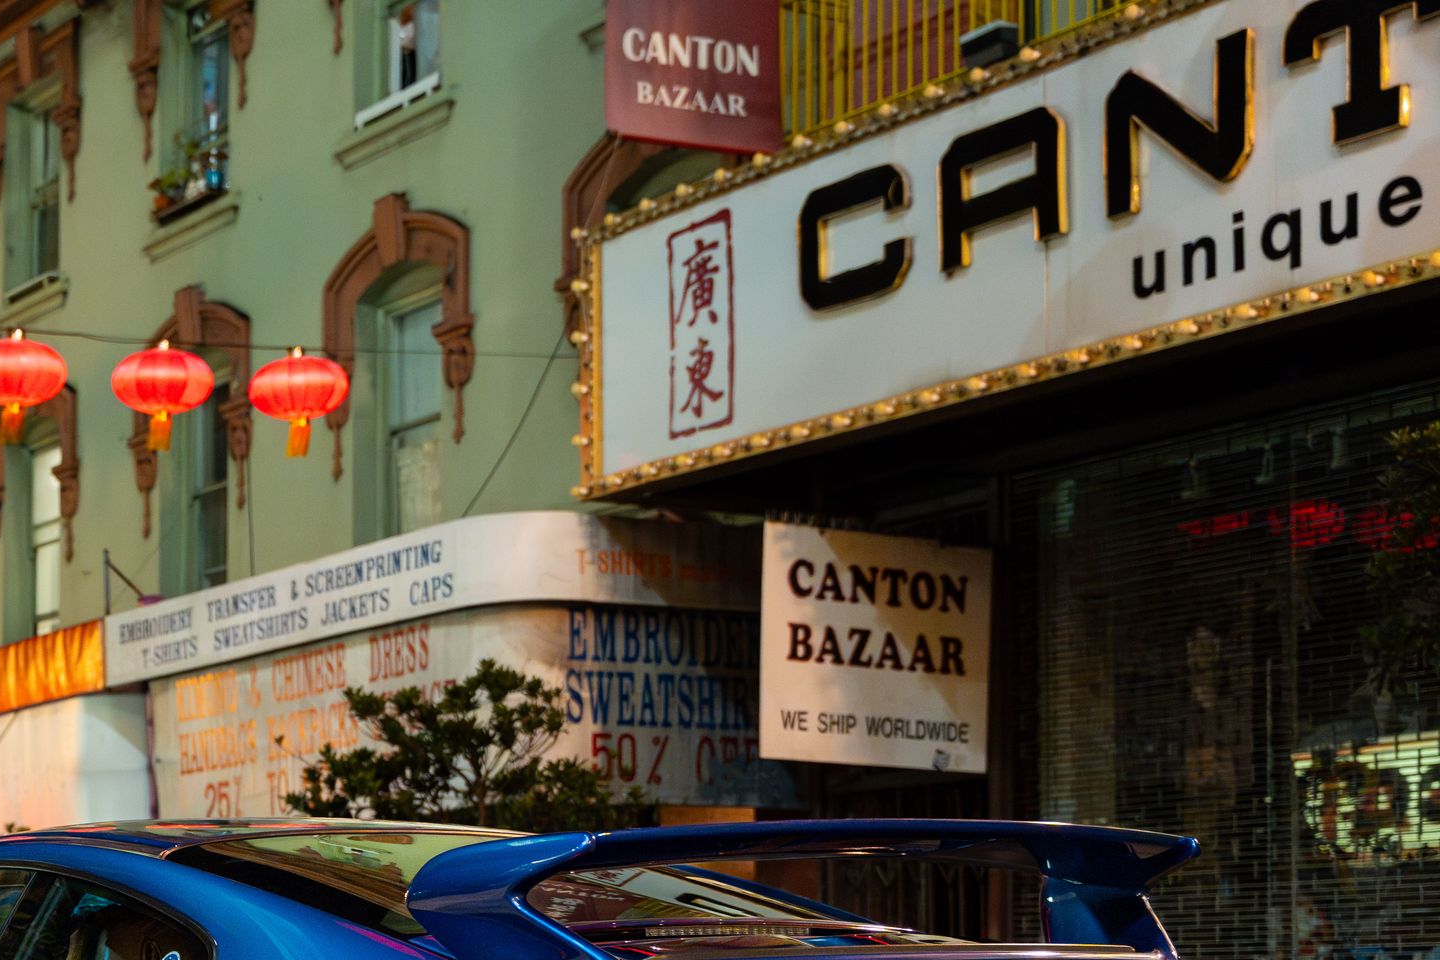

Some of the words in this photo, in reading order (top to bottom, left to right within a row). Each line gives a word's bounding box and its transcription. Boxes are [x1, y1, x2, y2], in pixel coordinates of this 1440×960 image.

[622, 27, 759, 77] CANTON
[637, 81, 748, 117] BAZAAR
[798, 0, 1440, 312] CANT
[1132, 175, 1423, 298] unique
[674, 238, 725, 418] 廣東
[576, 547, 672, 577] T-SHIRTS
[788, 559, 968, 614] CANTON
[119, 606, 195, 645] EMBROIDERY
[206, 584, 277, 622] TRANSFER
[213, 607, 308, 651] SWEATSHIRTS
[320, 588, 390, 626] JACKETS
[409, 572, 454, 607] CAPS
[271, 642, 346, 704] CHINESE
[368, 623, 430, 683] DRESS
[787, 622, 965, 676] BAZAAR
[781, 710, 809, 731] WE
[817, 713, 857, 735] SHIP
[866, 716, 970, 743] WORLDWIDE
